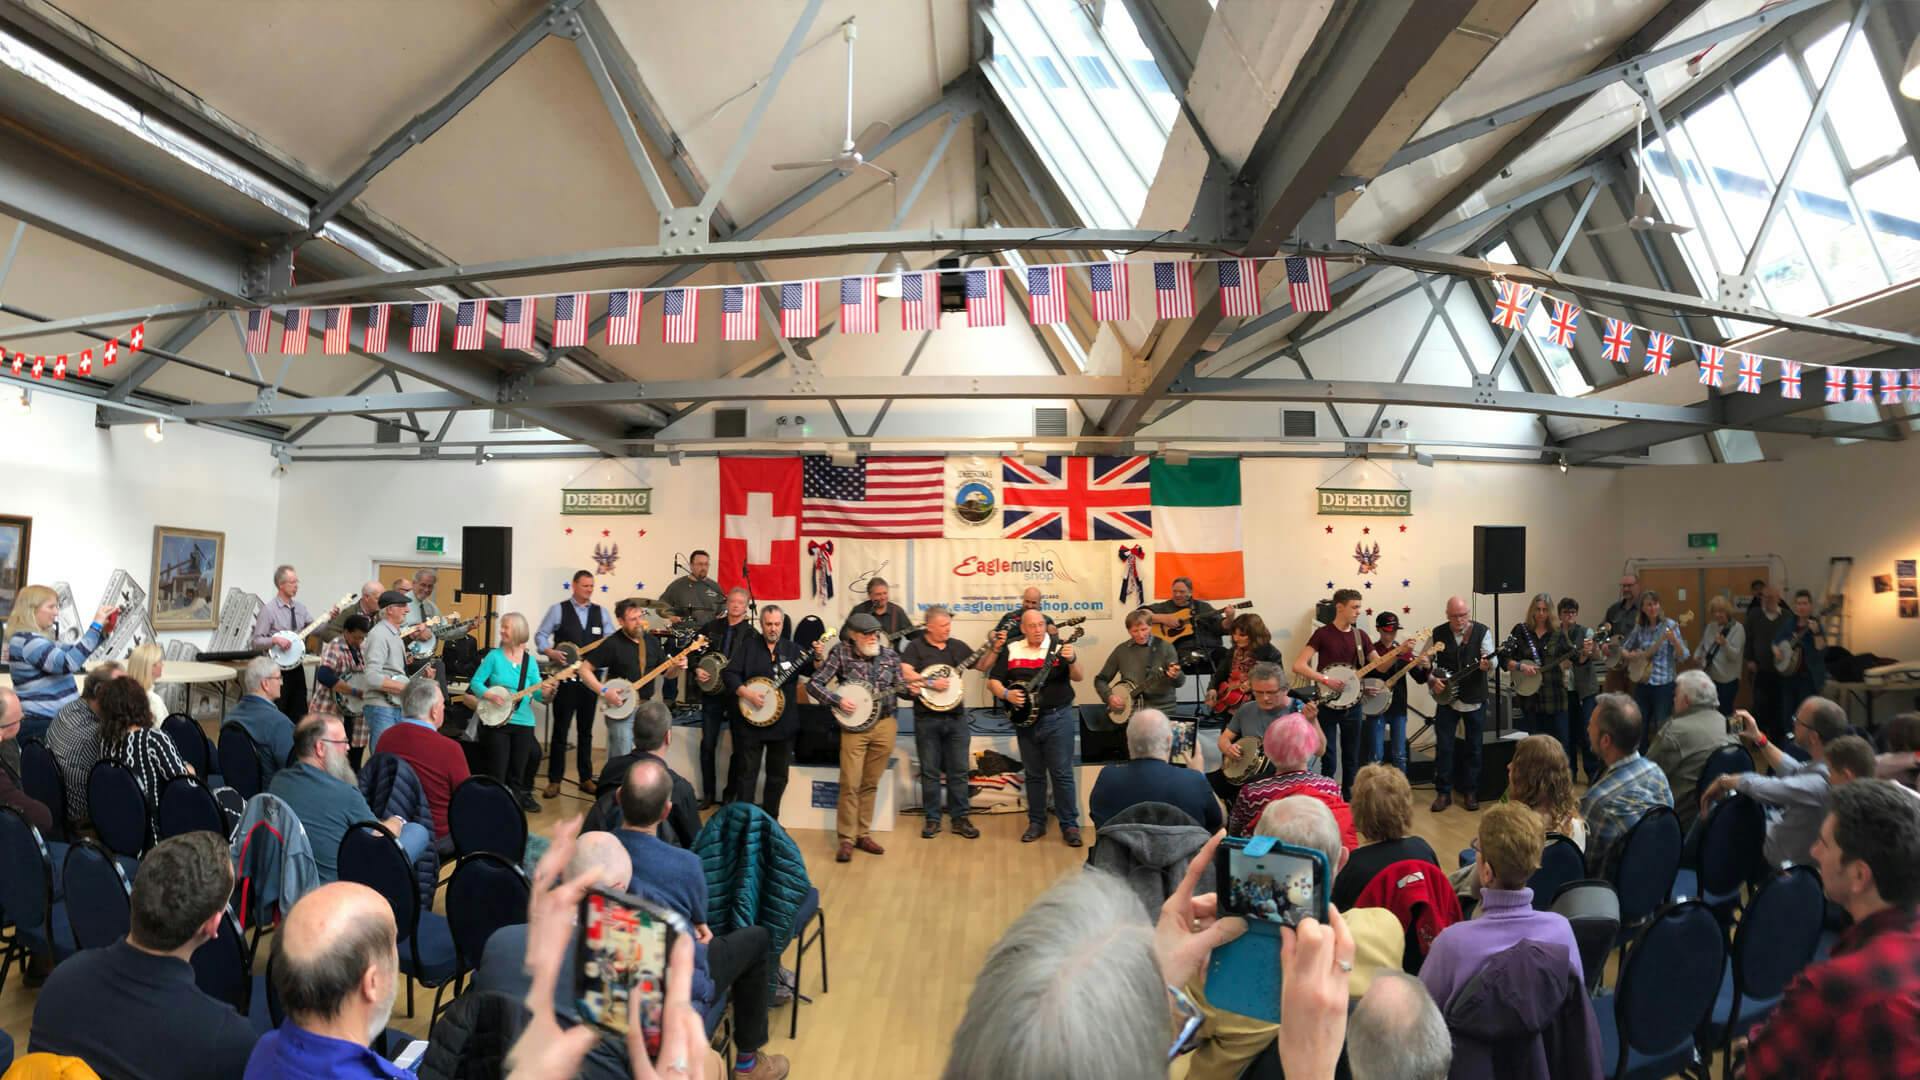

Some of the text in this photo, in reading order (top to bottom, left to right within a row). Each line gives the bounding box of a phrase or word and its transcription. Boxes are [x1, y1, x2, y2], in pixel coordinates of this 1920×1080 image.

[565, 493, 647, 506] DEERING
[1321, 493, 1408, 507] DEERING
[1024, 572, 1054, 582] shop
[917, 601, 1104, 614] w.eaglemushop.com
